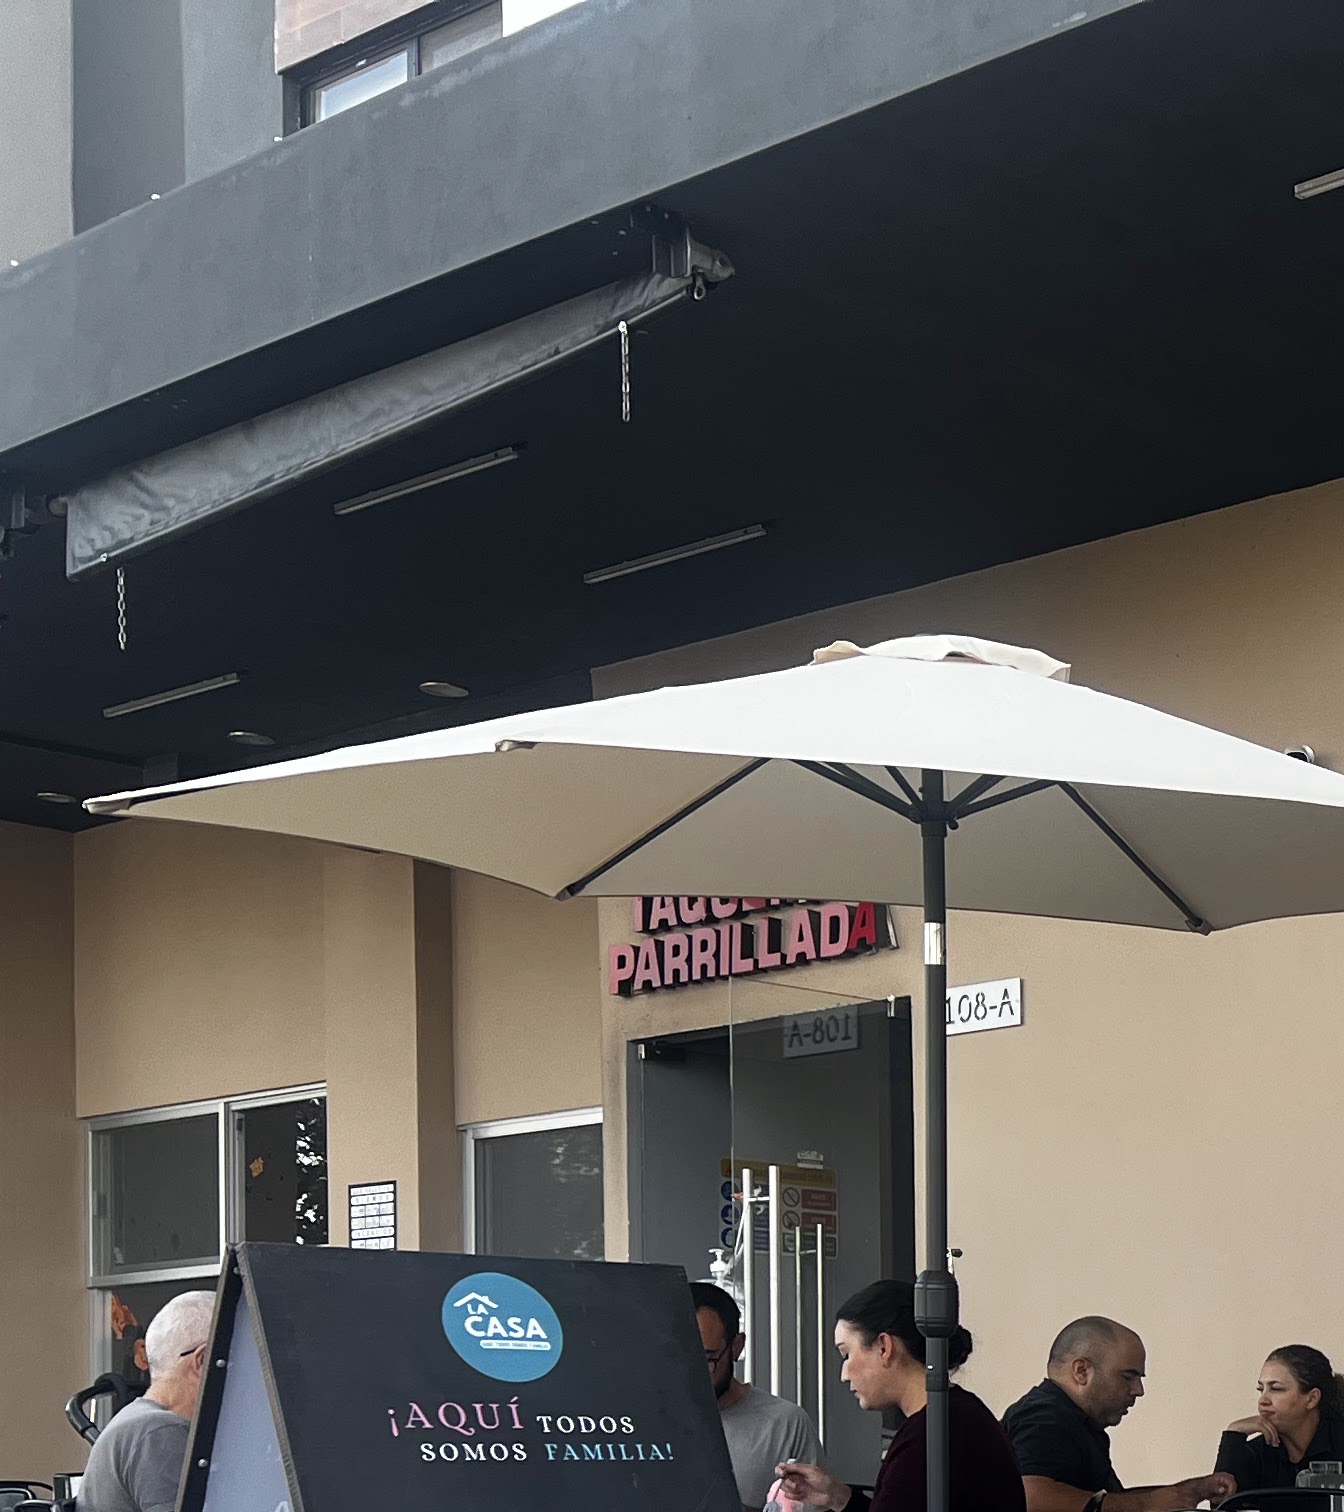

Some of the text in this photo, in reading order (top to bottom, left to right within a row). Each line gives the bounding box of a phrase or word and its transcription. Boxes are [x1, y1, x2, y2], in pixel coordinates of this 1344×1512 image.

[608, 902, 877, 994] PARRILLADA
[467, 1303, 489, 1315] LA
[464, 1315, 548, 1339] CASA
[388, 1396, 635, 1437] ¡AQUÍ TODOS
[420, 1442, 674, 1462] SOMOS FAMILIA!
